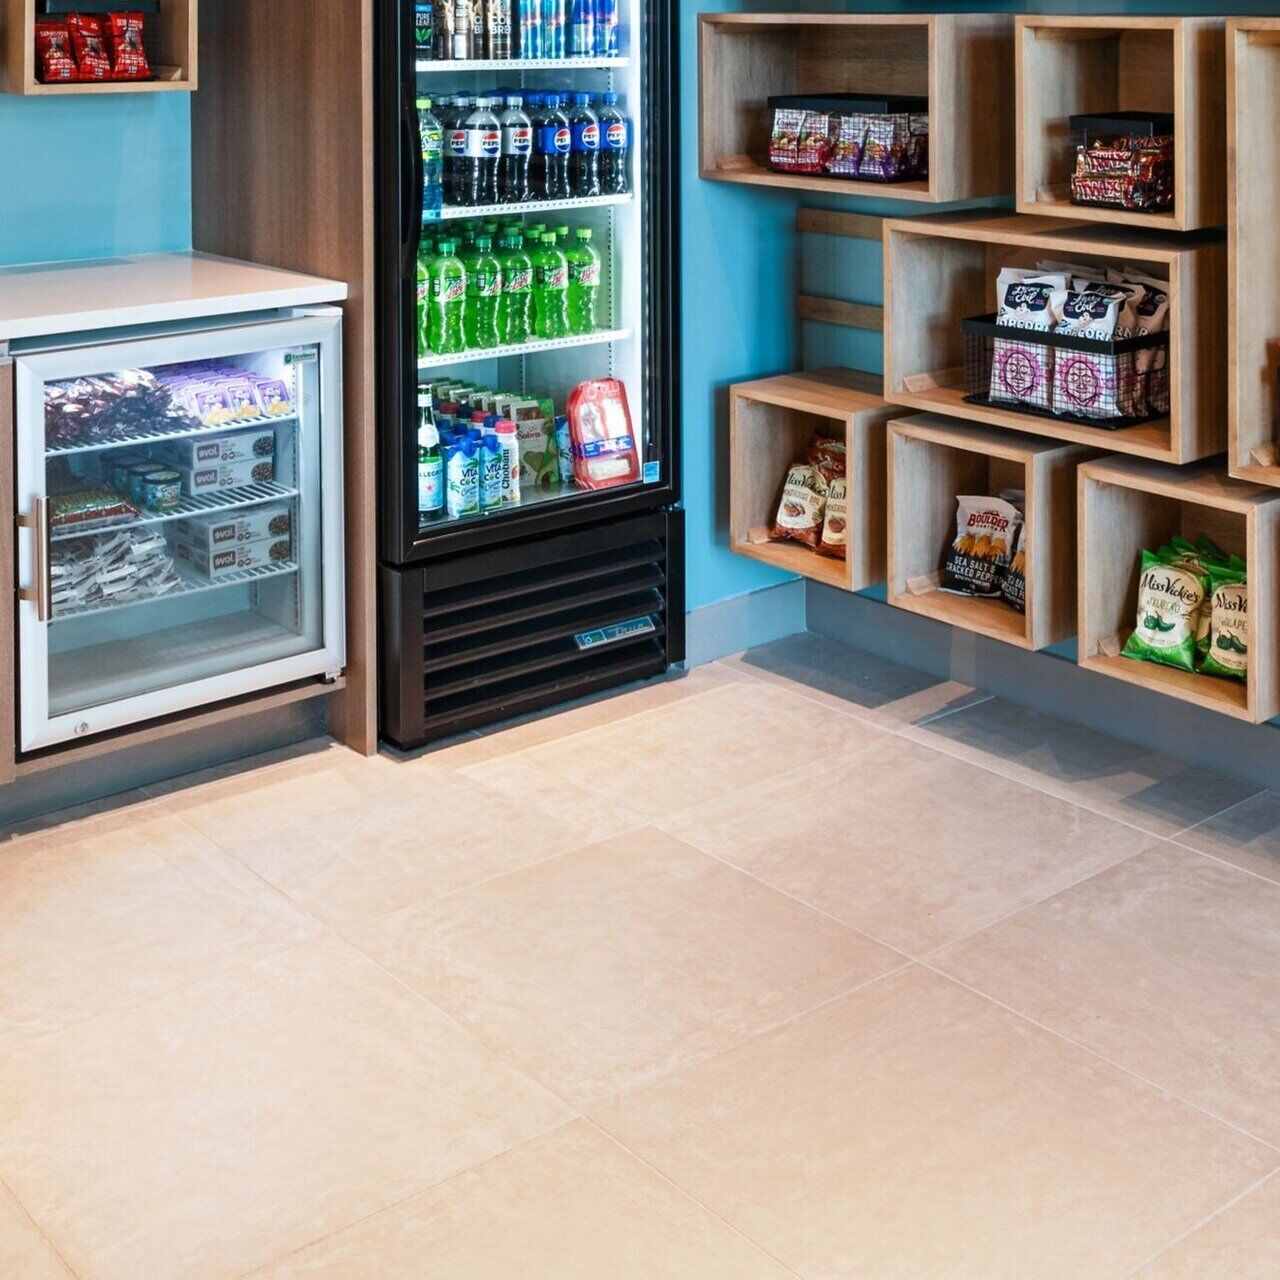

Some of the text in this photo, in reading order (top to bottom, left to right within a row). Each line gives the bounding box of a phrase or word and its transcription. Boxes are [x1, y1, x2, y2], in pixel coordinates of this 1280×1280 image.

[501, 449, 510, 489] Chobani
[967, 513, 1009, 532] BOULDER
[954, 555, 967, 566] SEA
[970, 558, 987, 572] SALT
[1141, 573, 1200, 605] Miss Vickie's
[1216, 593, 1236, 612] Miss
